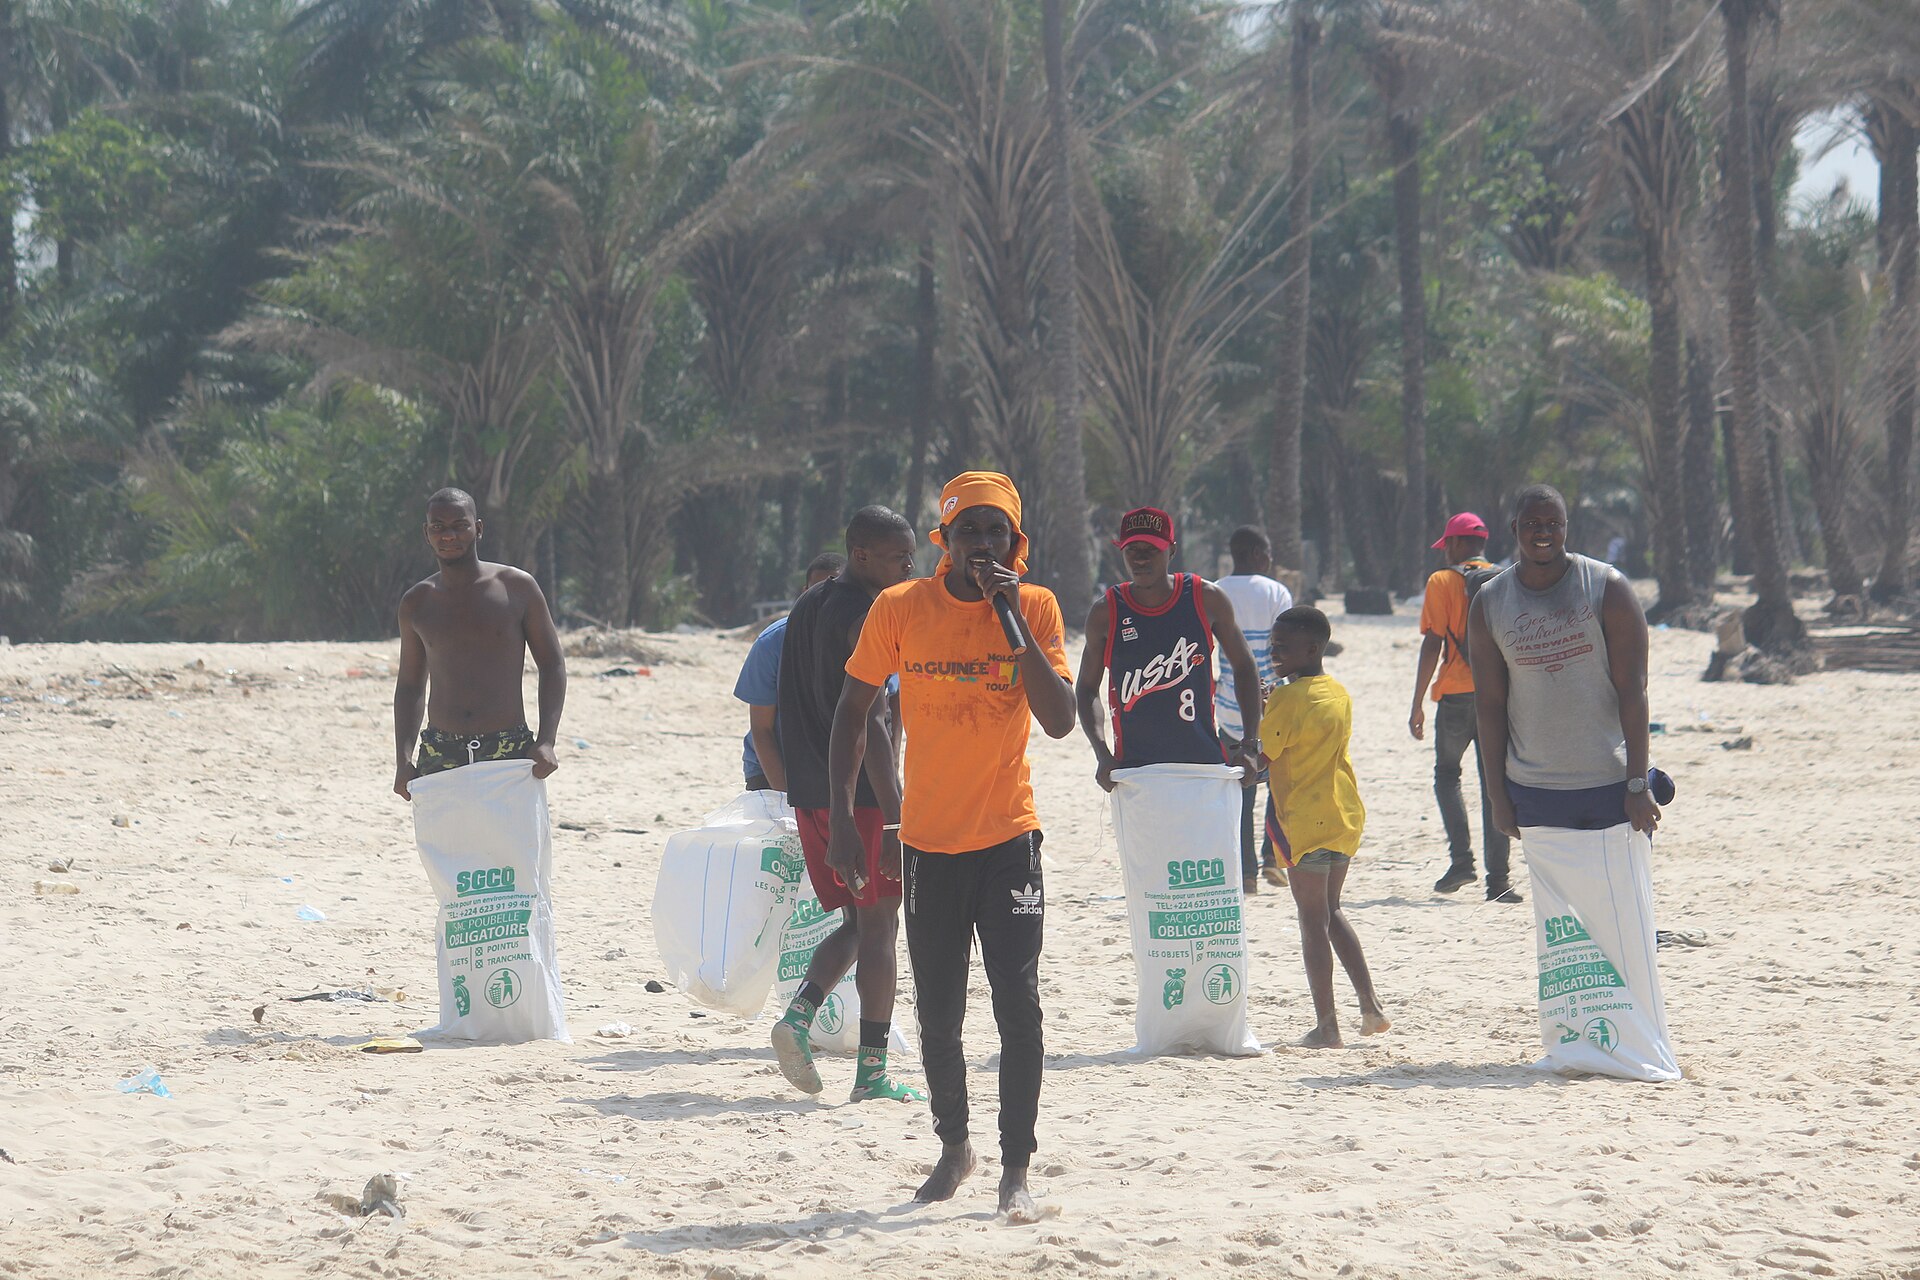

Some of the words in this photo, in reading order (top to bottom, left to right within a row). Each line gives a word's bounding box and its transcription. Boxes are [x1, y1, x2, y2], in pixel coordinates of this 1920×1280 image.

[1515, 631, 1585, 652] HARDWARE
[924, 657, 990, 675] GUINÉE
[1120, 637, 1198, 704] USA
[985, 682, 1010, 692] TOUT
[1178, 688, 1196, 722] 8
[754, 881, 768, 891] LES
[459, 899, 472, 909] pour
[460, 907, 478, 918] +224
[479, 904, 494, 914] 623
[496, 902, 506, 911] 91
[508, 901, 518, 909] 99
[519, 900, 530, 908] 48
[1012, 904, 1043, 914] adidas
[1194, 899, 1209, 908] 623
[1210, 898, 1220, 906] 91
[1222, 897, 1232, 905] 99
[468, 911, 521, 929] POUBELLE
[1164, 913, 1183, 923] SAC
[1185, 908, 1236, 923] POUBELLE
[449, 923, 528, 947] OBLIGATOIRE
[1158, 919, 1241, 937] OBLIGATOIRE
[487, 940, 519, 953] POINTUS
[807, 935, 819, 946] 623
[1161, 950, 1190, 958] OBJETS
[1208, 938, 1239, 947] POINTUS
[784, 952, 799, 965] SAC
[1559, 962, 1606, 980] POUBELLE
[1543, 973, 1616, 998] OBLIGATOIRE
[1580, 991, 1614, 1001] POINTUS
[1582, 1003, 1633, 1015] TRANCHANTS
